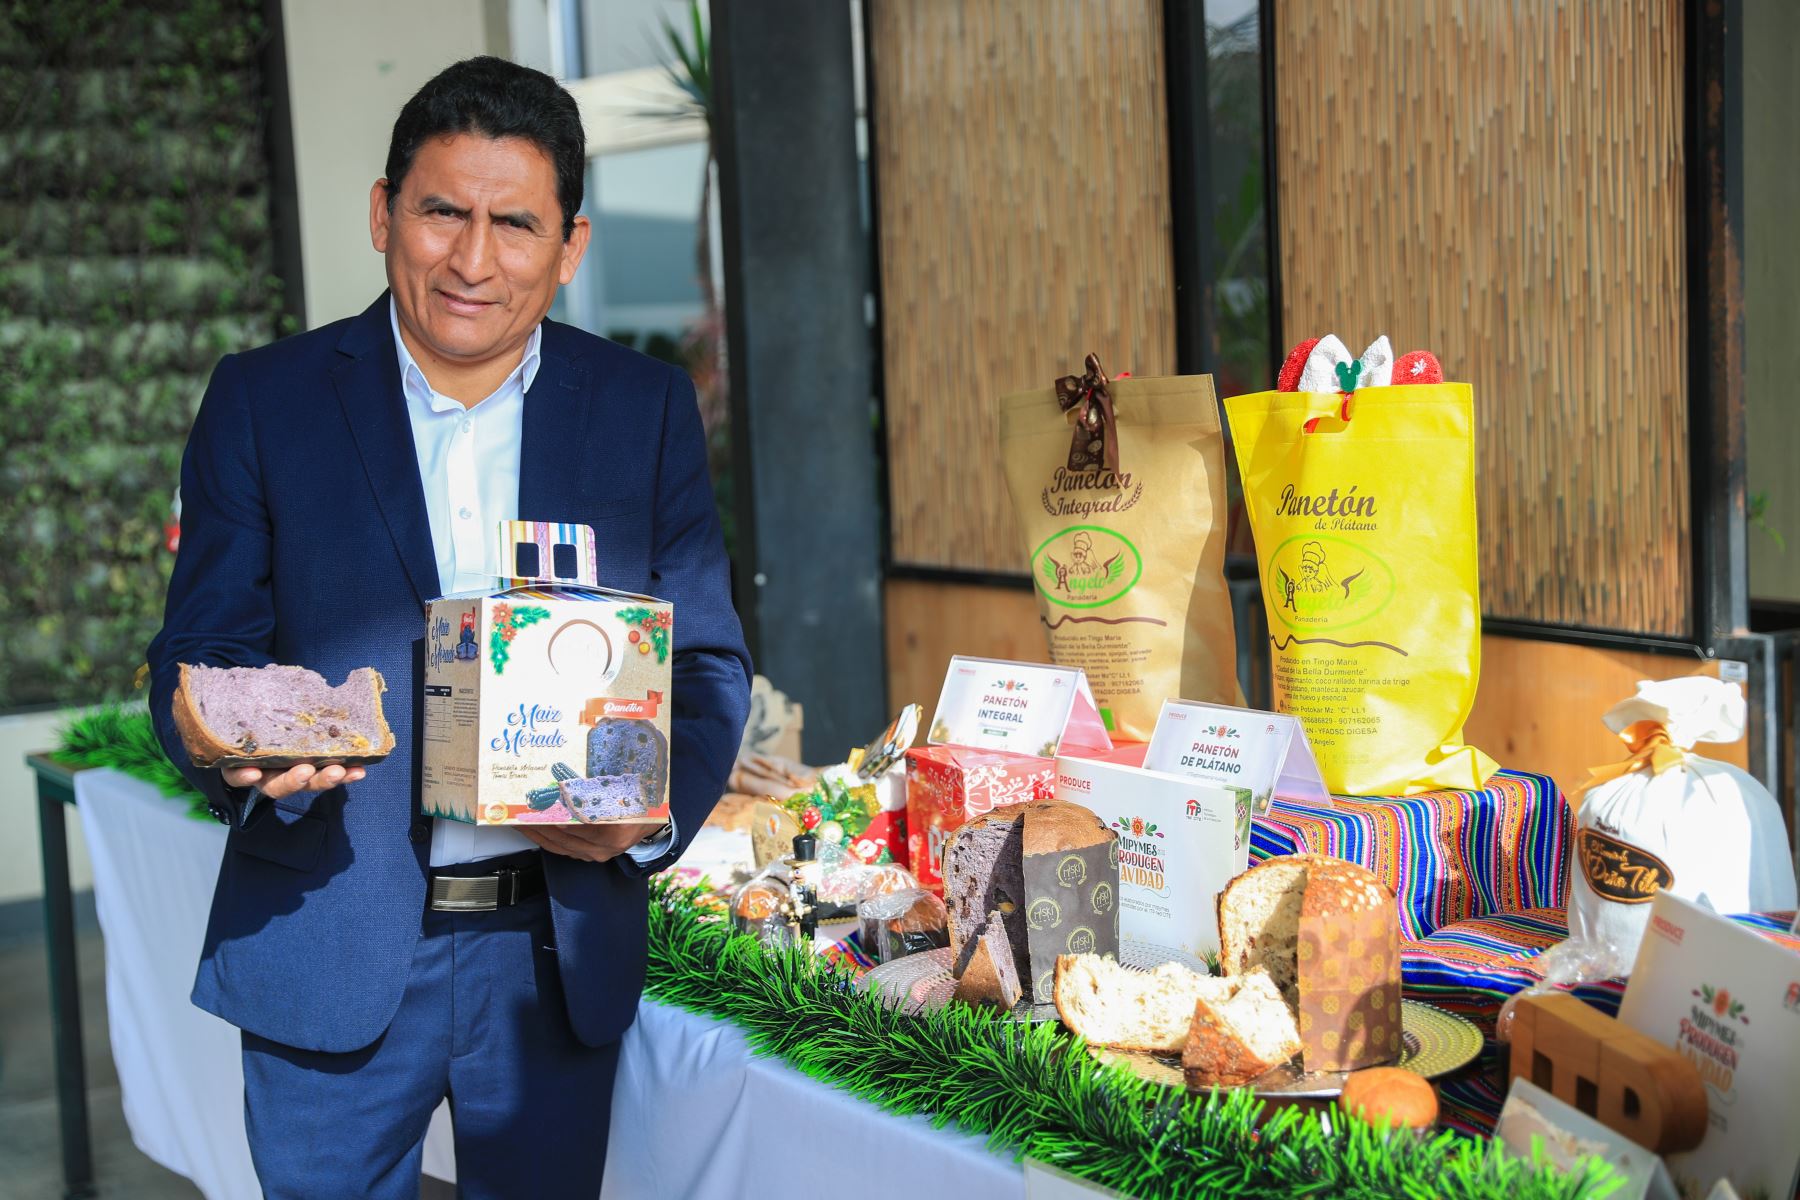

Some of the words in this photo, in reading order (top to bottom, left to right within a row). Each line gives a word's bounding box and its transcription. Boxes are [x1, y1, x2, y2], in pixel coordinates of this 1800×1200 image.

[1055, 493, 1123, 519] Integral
[1276, 483, 1378, 517] Panetón
[1314, 518, 1327, 530] de
[1330, 518, 1377, 531] Plátano
[1313, 658, 1335, 667] Tingo
[1303, 667, 1322, 675] Bella
[1323, 668, 1367, 676] Durmiente"
[1358, 677, 1381, 686] harina
[1382, 677, 1391, 686] de
[1393, 678, 1411, 687] trigo
[603, 702, 644, 713] Panetón
[983, 695, 1028, 708] PANETÓN
[978, 709, 1024, 724] INTEGRAL
[1346, 727, 1378, 735] DIGESA
[490, 728, 568, 757] Morado
[1192, 742, 1240, 759] PANETÓN
[1180, 755, 1195, 767] DE
[1196, 757, 1242, 774] PLÁTANO
[1059, 774, 1092, 790] PRODUCE
[1186, 804, 1202, 817] ITP
[1118, 849, 1165, 873] RODUCEN
[1119, 864, 1165, 890] AVIDAD
